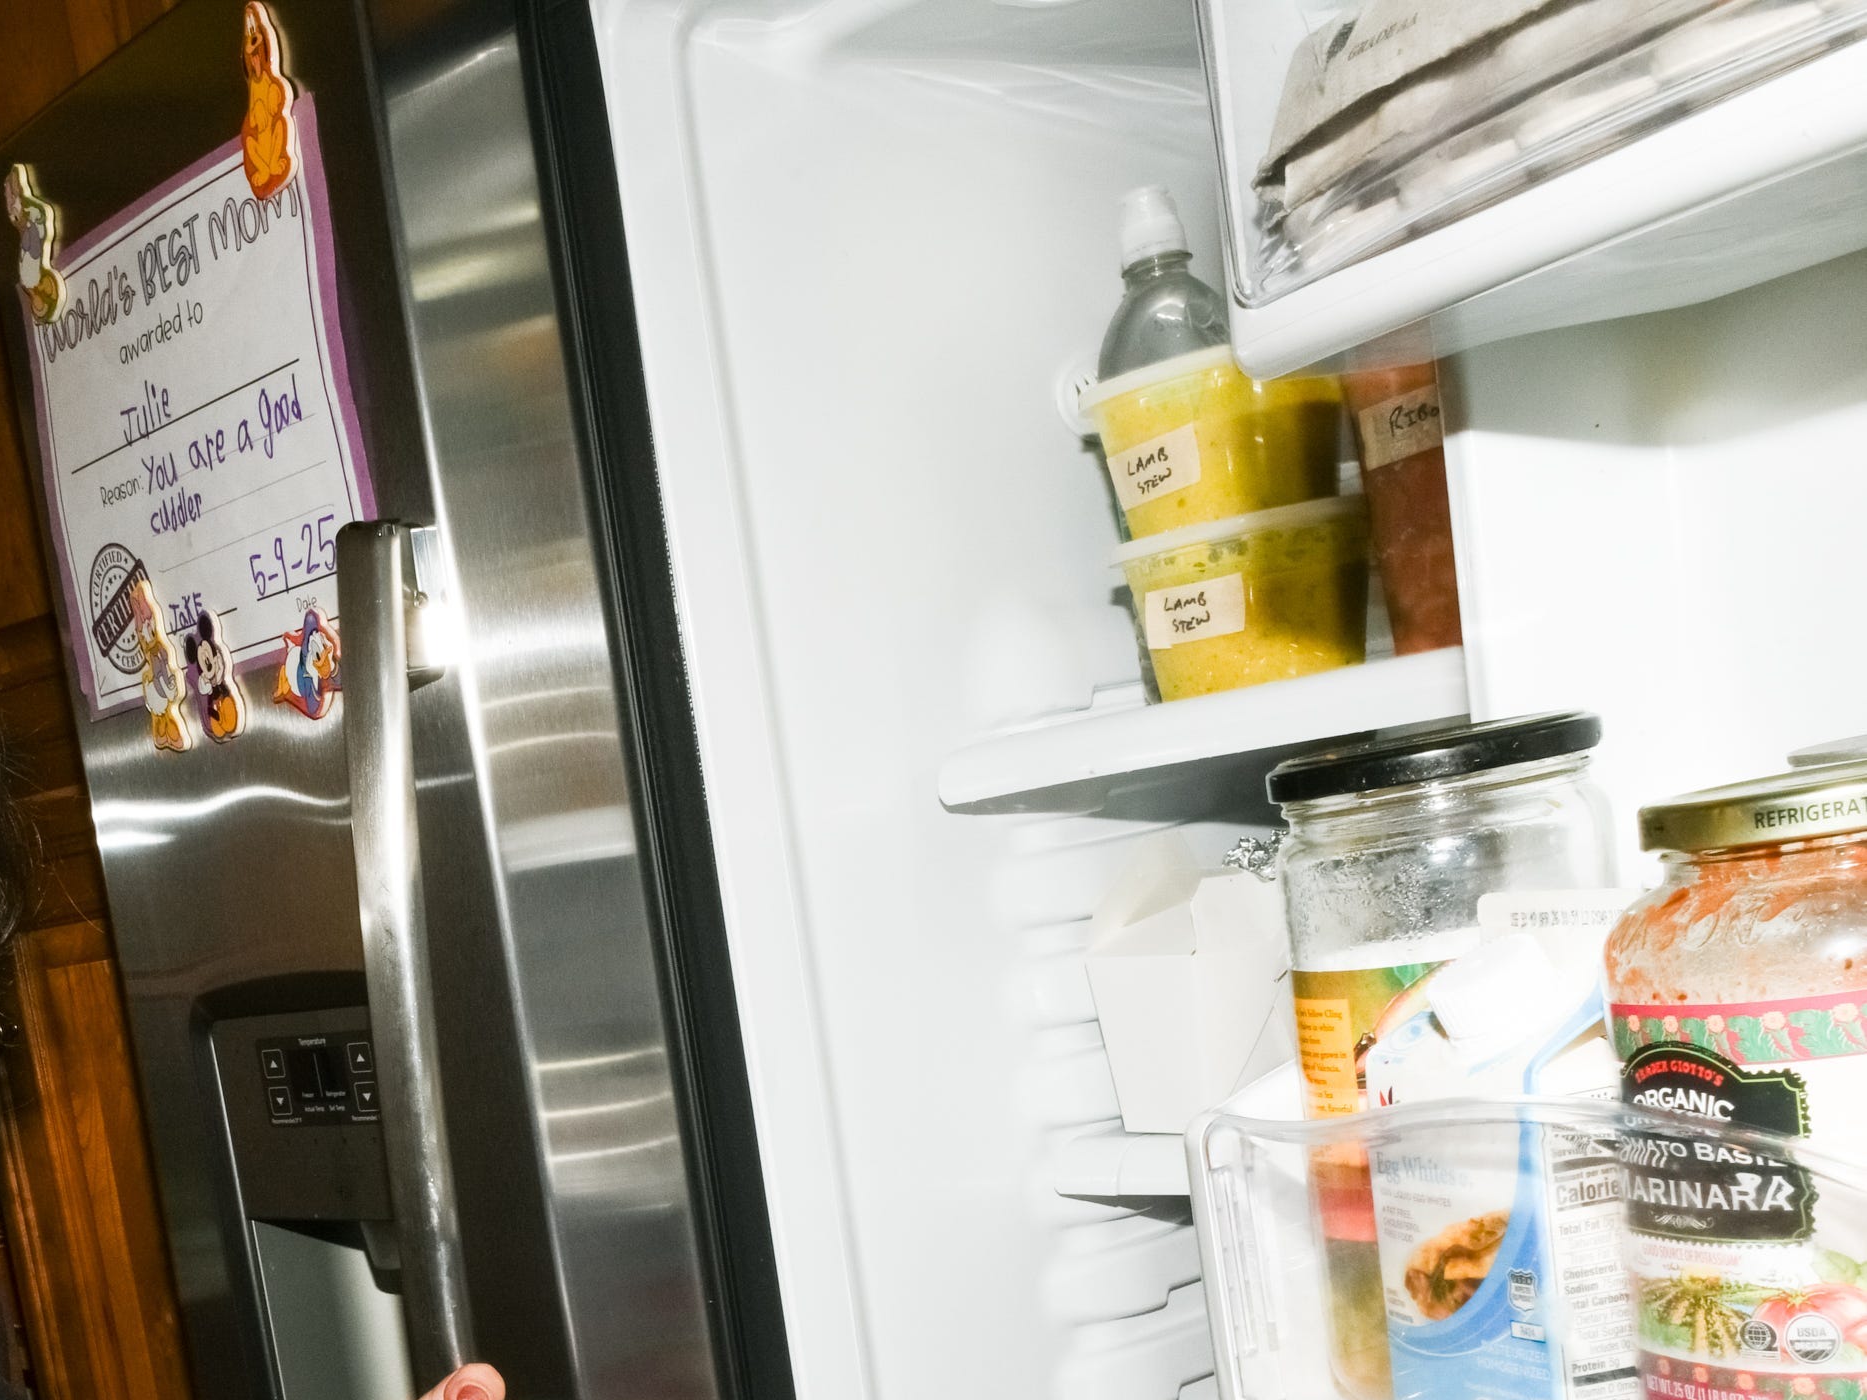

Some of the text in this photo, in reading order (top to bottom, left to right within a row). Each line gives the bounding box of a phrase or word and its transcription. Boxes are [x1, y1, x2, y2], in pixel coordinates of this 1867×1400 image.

[39, 265, 136, 363] World's
[138, 213, 200, 306] BEST
[119, 300, 203, 365] awarded to
[120, 380, 171, 447] Julie
[141, 373, 302, 495] You are a good
[1127, 447, 1169, 476] LAMB
[100, 475, 144, 507] Reason:
[1137, 467, 1172, 495] STEW
[150, 490, 202, 534] cuddler
[249, 514, 336, 596] 5-9-25
[92, 551, 123, 597] CERTIFIED
[296, 596, 317, 613] Date
[1163, 591, 1207, 612] LAMB
[1171, 611, 1211, 634] STEW
[298, 1038, 327, 1047] Temperature
[1670, 1060, 1724, 1087] GIOTTO'S
[1633, 1087, 1735, 1121] ORGANIC
[1376, 1151, 1456, 1185] Egg Whites
[1556, 1177, 1619, 1205] Calorie
[1559, 1223, 1581, 1236] Total
[1563, 1262, 1617, 1281] Cholesterol
[1564, 1282, 1598, 1296] Sodium
[1797, 1327, 1826, 1337] USDA
[1572, 1361, 1606, 1374] Protein
[1673, 1380, 1684, 1397] 25
